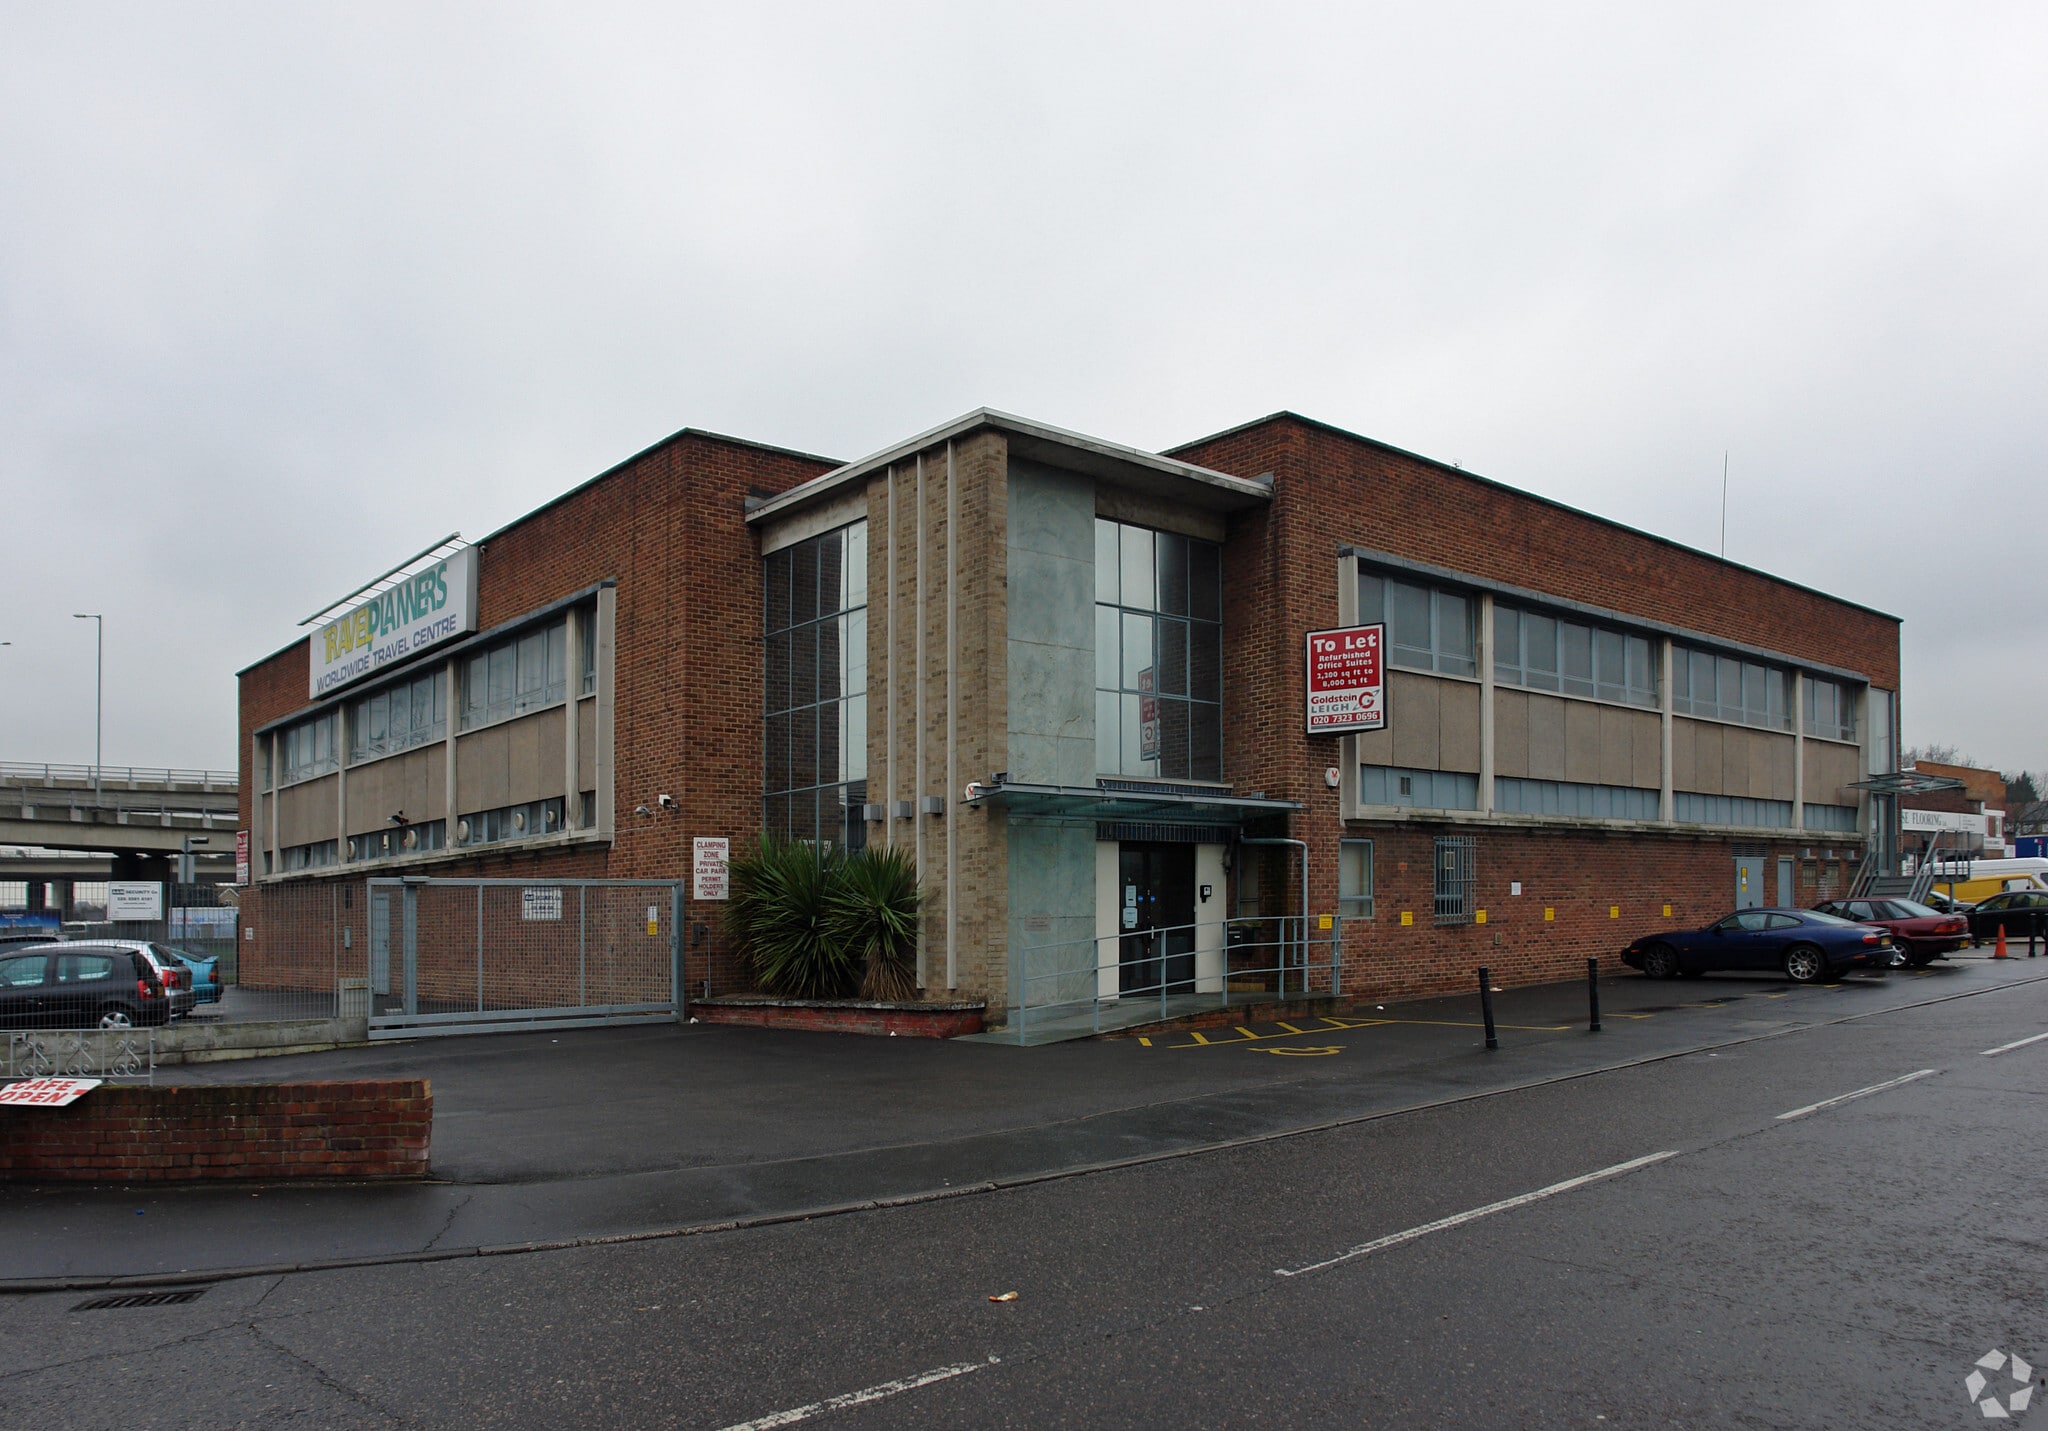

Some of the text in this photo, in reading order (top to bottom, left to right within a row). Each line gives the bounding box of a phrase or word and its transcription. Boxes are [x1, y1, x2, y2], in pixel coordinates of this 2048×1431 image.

[1313, 633, 1377, 653] To Let
[316, 613, 457, 692] WORLDWIDE TRAVEL CENTRE
[1319, 650, 1370, 662] Refurbished
[1317, 659, 1372, 670] Office Suites
[1311, 693, 1357, 705] Goldstein
[1311, 703, 1350, 714] LEIGH
[1313, 711, 1378, 725] 020 7323 0696
[1912, 812, 1942, 825] FLOORING
[11, 1079, 77, 1091] CAFE
[0, 1091, 68, 1103] OPEN
